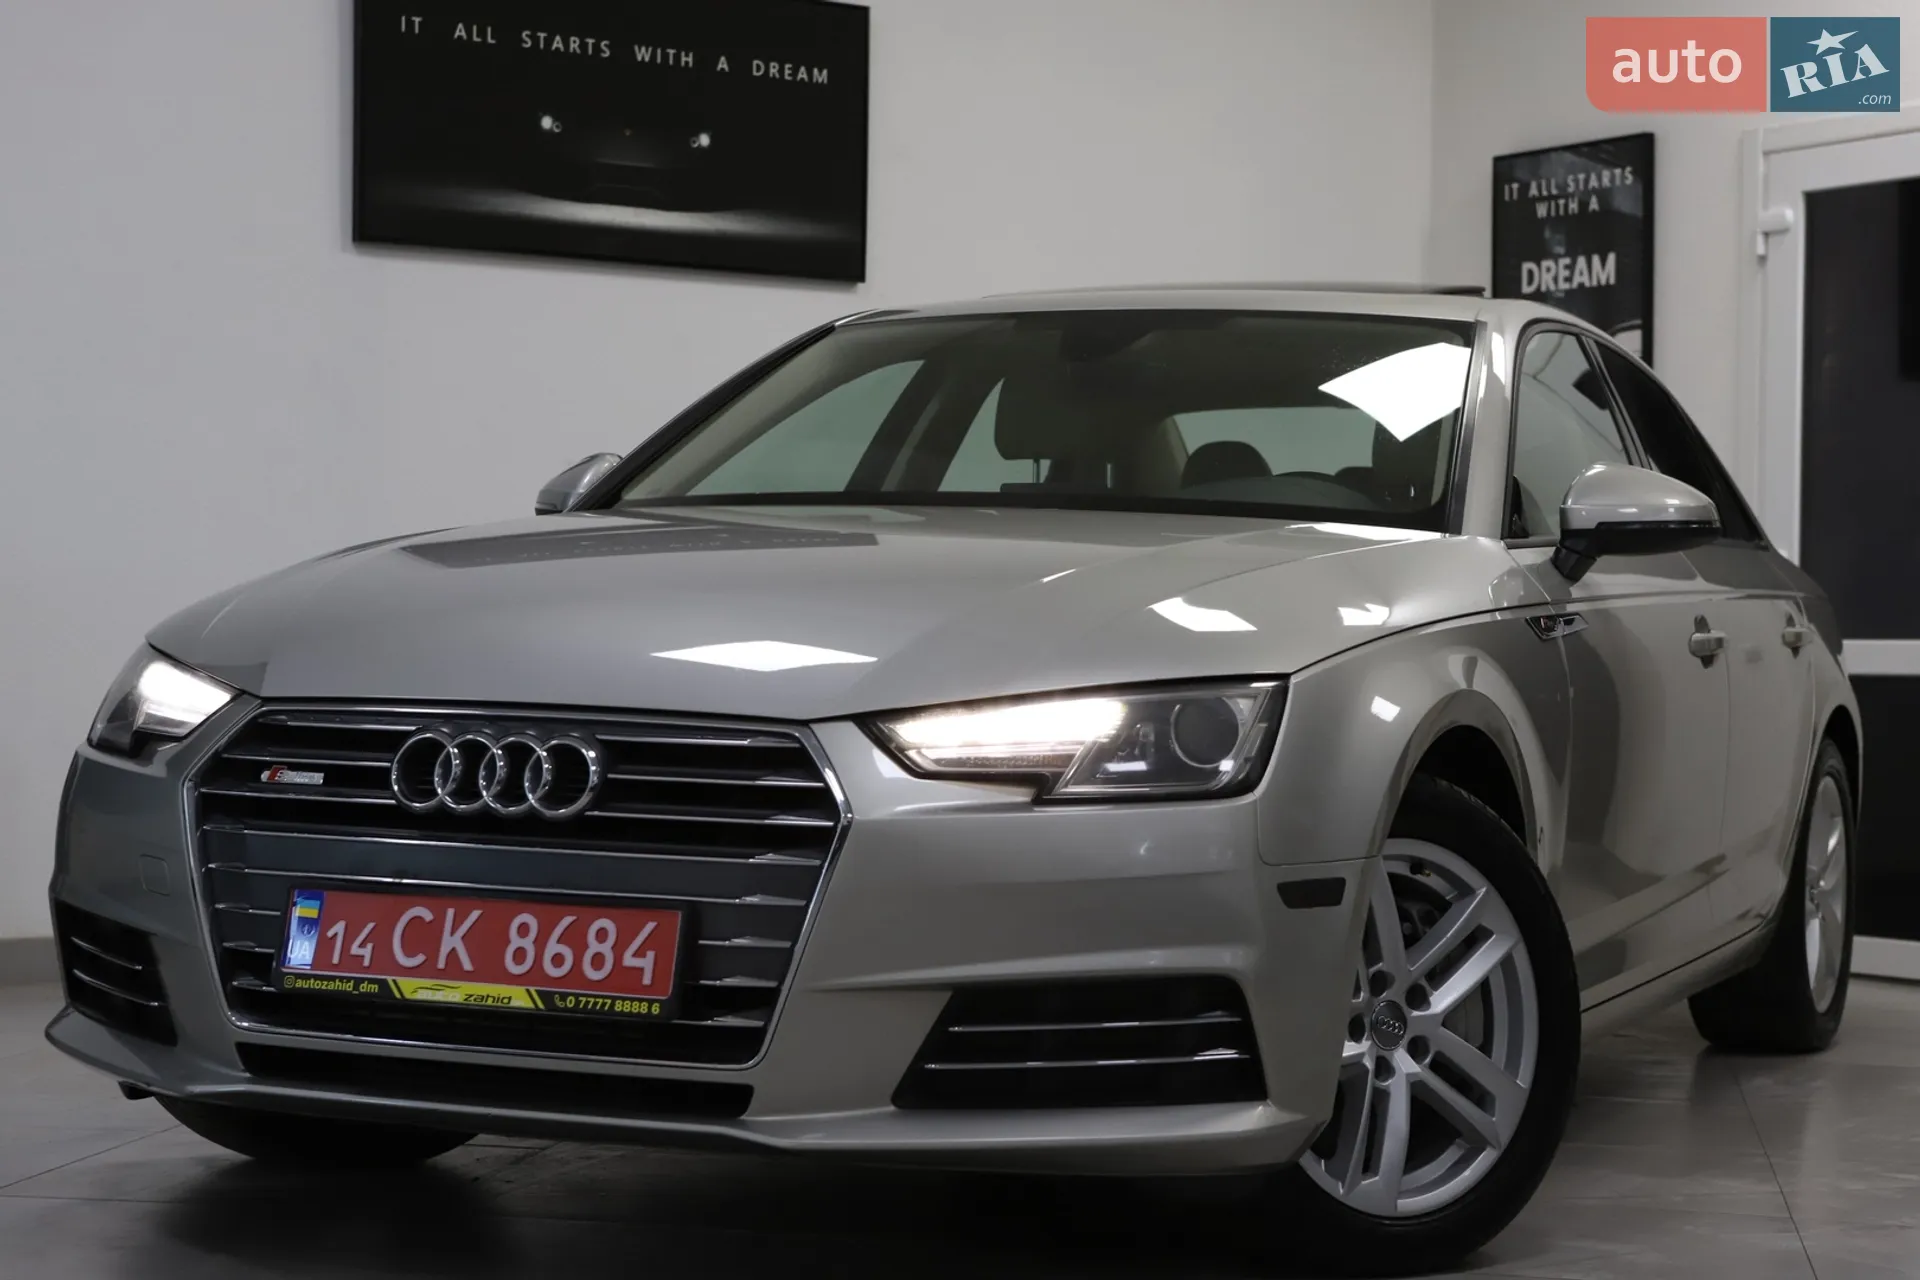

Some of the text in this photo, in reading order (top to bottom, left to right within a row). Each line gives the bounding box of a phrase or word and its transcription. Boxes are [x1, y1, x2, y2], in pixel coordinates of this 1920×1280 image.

[401, 15, 828, 84] IT ALL STARTS WITH A DREAM
[1504, 166, 1634, 201] IT ALL STARTS
[1535, 194, 1600, 219] WITH A
[1521, 251, 1617, 294] DREAM
[289, 939, 311, 959] UA
[326, 906, 659, 986] 14 CK 8684
[463, 992, 512, 1006] zahid
[566, 996, 660, 1015] 0 7777 8888 6
